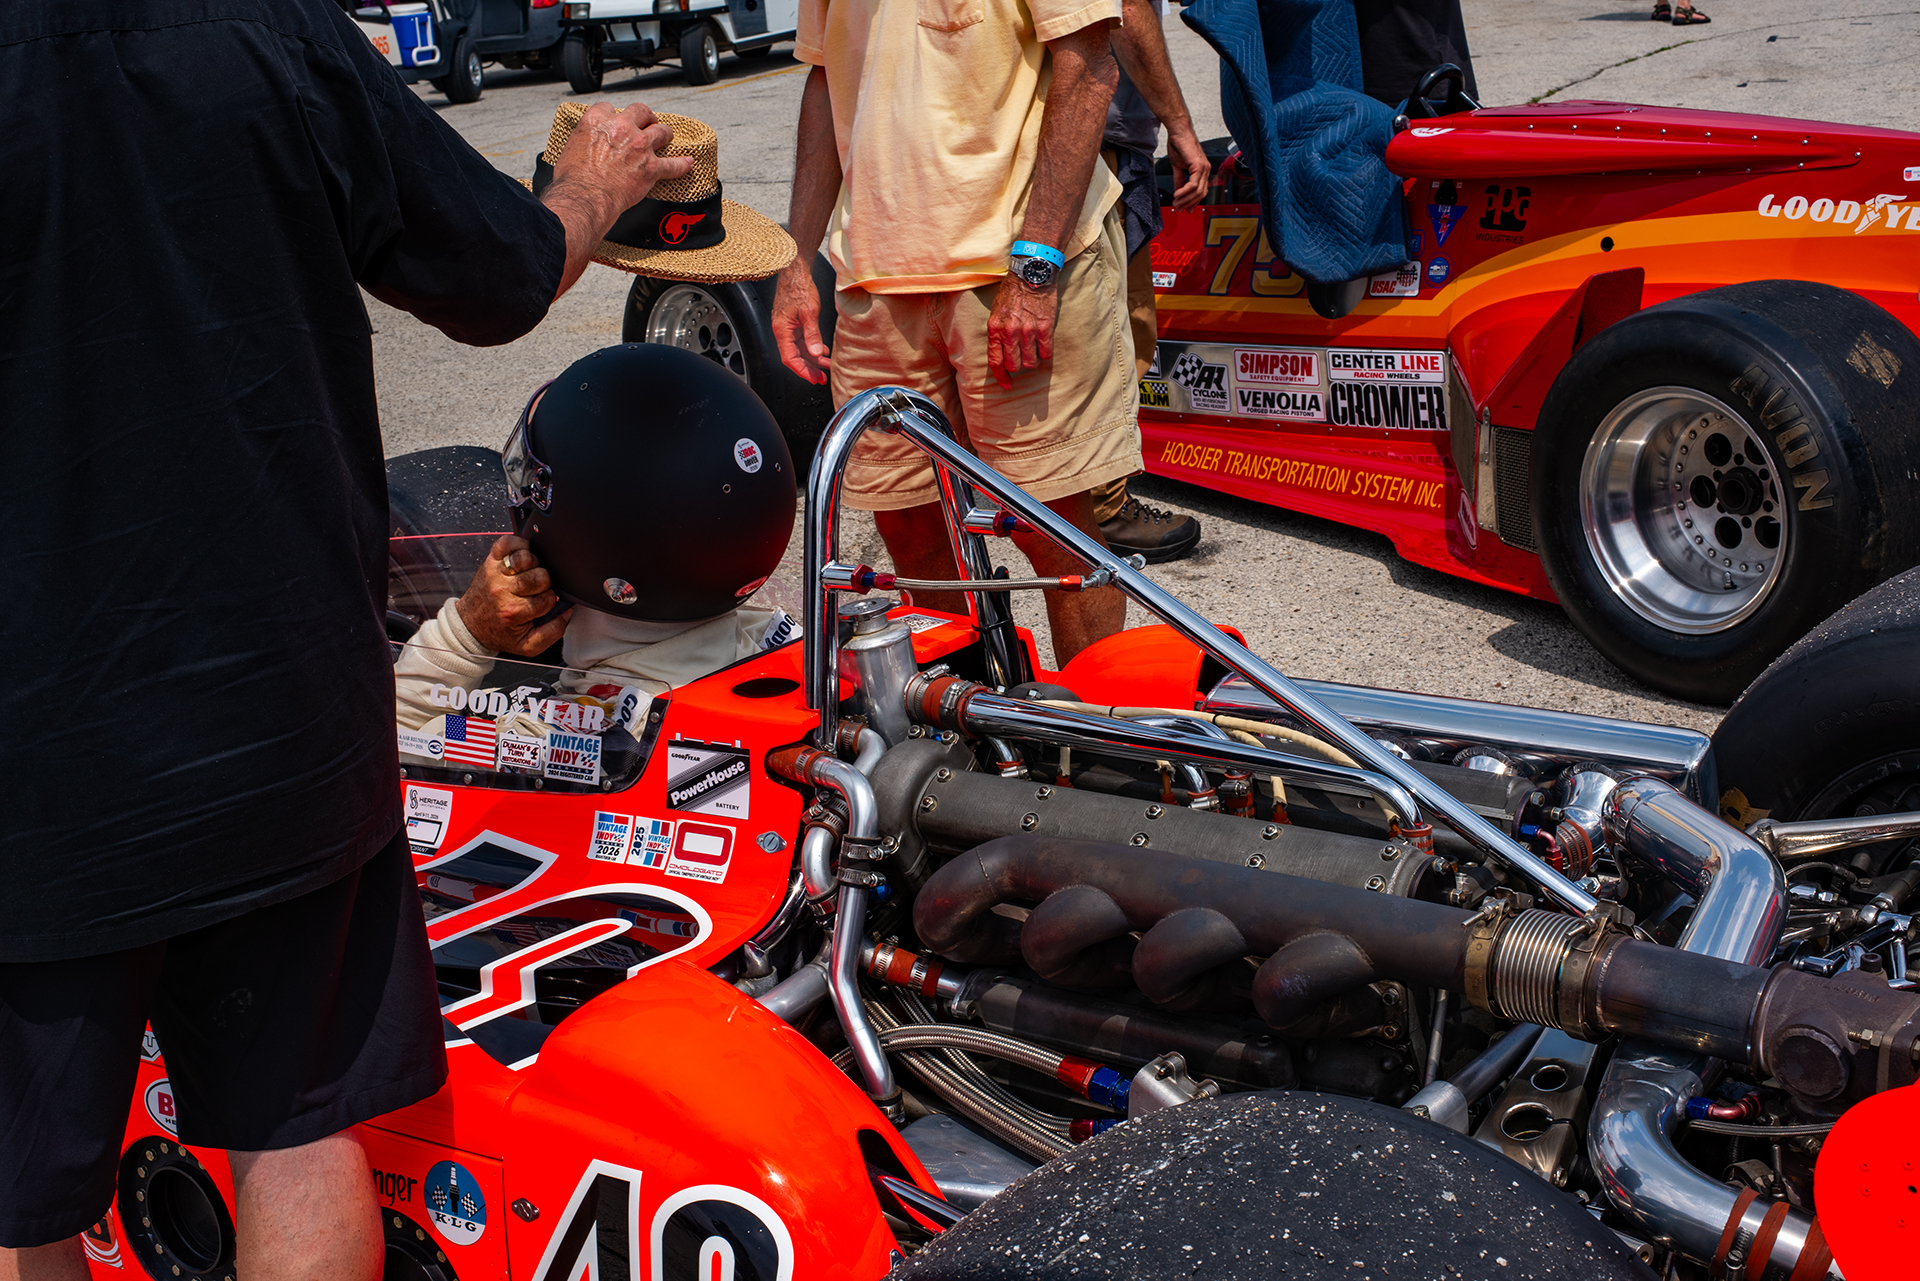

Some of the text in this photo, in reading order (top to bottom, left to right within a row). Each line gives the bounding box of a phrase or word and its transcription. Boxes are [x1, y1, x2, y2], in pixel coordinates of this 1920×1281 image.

[1475, 232, 1524, 245] INDUSTRIES
[1371, 280, 1397, 294] USAC
[1240, 353, 1313, 377] SIMPSON
[1331, 354, 1440, 371] CENTER LINE
[1354, 371, 1385, 379] RACING
[1192, 388, 1228, 400] CYCLONE
[1239, 390, 1321, 412] VENOLIA
[1331, 382, 1448, 430] CROWER
[1729, 365, 1834, 511] AVON
[1161, 440, 1443, 509] HOOSIER TRANSPORTATION SYSTEM INC.
[430, 683, 605, 730] GOODYEAR
[502, 740, 531, 752] DUMAN'S
[550, 733, 600, 753] VINTAGE
[507, 748, 525, 758] TURN
[530, 746, 540, 760] 4
[549, 748, 580, 766] INDY
[671, 752, 700, 763] GOODYEAR
[502, 755, 531, 766] RESTORATIONS
[670, 761, 746, 806] PowerHouse
[419, 797, 448, 806] HERITAGE
[715, 802, 740, 811] BATTERY
[597, 822, 628, 834] VINTAGE
[596, 831, 615, 841] INDY
[631, 826, 646, 857] 2025
[648, 834, 672, 845] VINTAGE
[596, 845, 620, 857] 2026
[647, 841, 661, 849] INDY
[669, 863, 724, 877] OMOLOGATO
